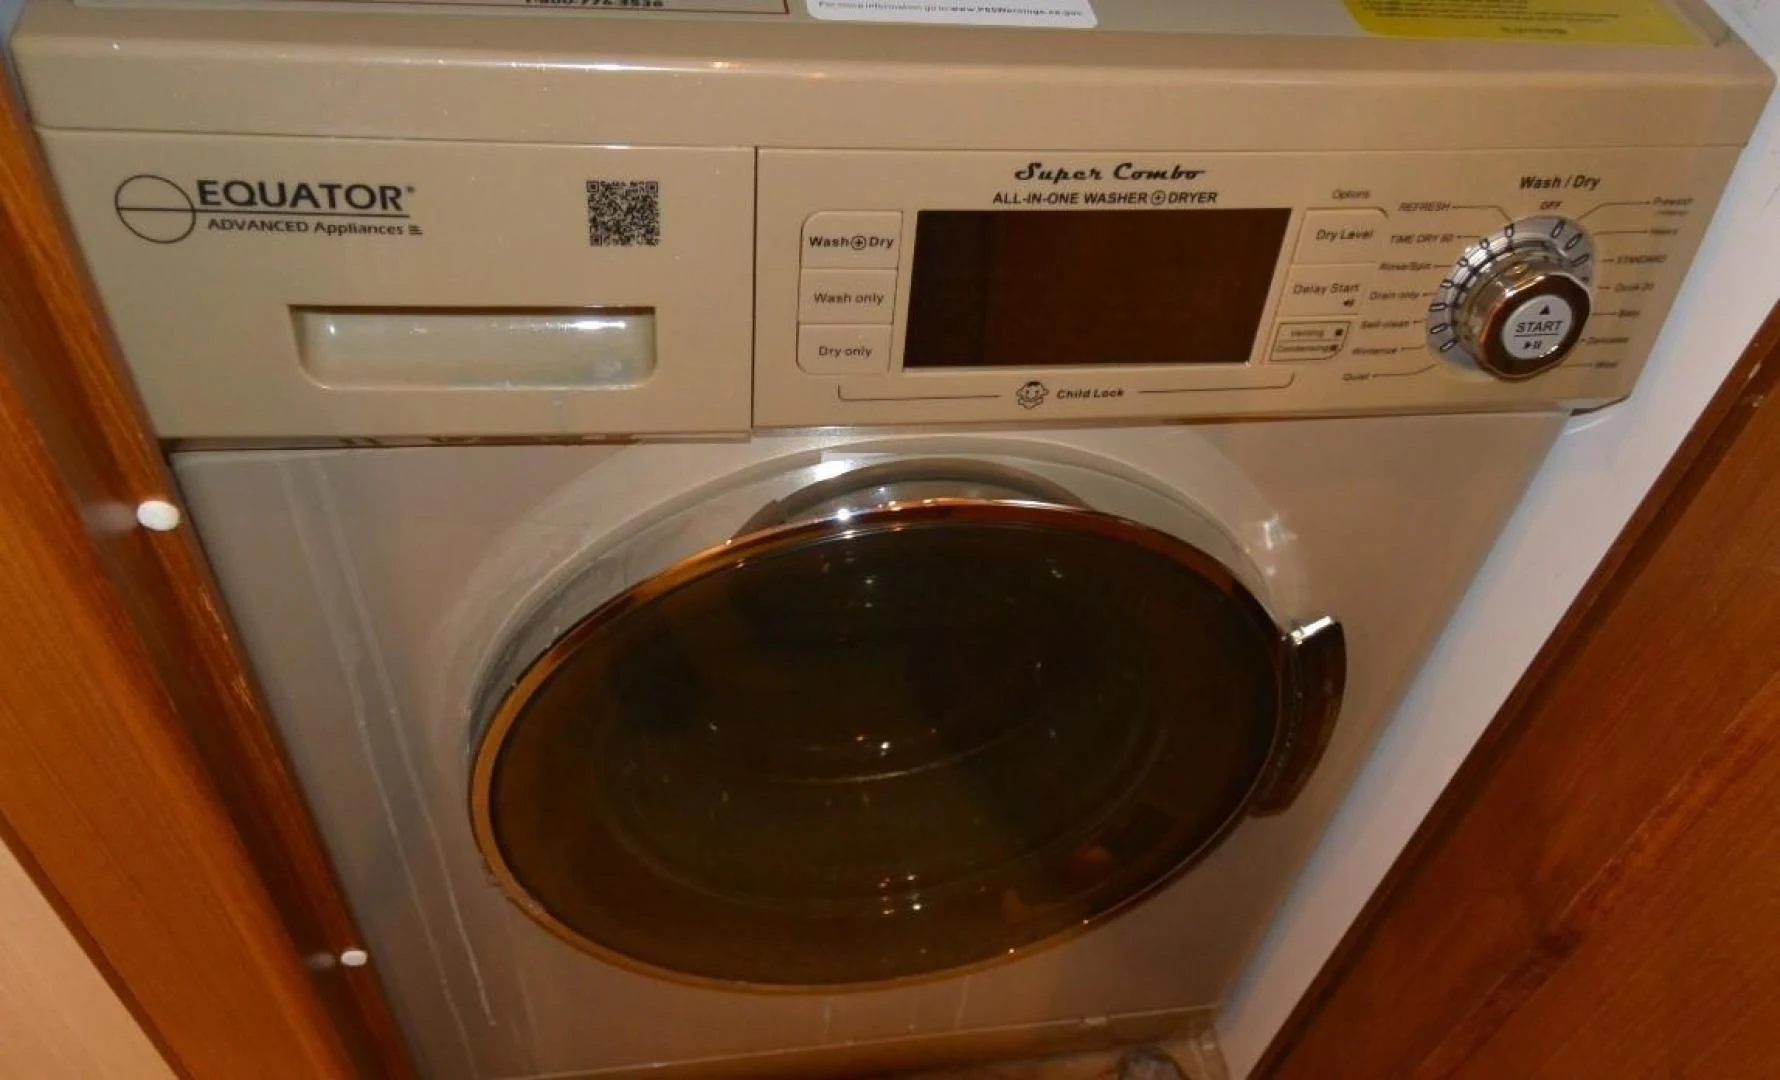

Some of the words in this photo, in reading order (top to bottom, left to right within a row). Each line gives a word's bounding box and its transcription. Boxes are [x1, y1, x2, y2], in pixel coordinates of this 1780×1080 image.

[1014, 162, 1104, 184] Super
[1112, 162, 1206, 181] Combo
[1520, 175, 1562, 189] Wash
[1573, 174, 1602, 191] Dry
[196, 179, 404, 211] EQUATOR
[992, 191, 1080, 205] ALL-IN-ONE
[1084, 191, 1148, 205] WASHER
[1168, 191, 1219, 205] DRYER
[207, 218, 309, 234] ADVANCED
[314, 221, 404, 237] Appliances
[1315, 228, 1338, 242] Dry
[1340, 229, 1374, 240] Level
[809, 236, 850, 248] Wash
[869, 236, 894, 248] Dry
[1293, 284, 1328, 295] Delay
[1329, 282, 1360, 294] Start
[813, 292, 851, 304] Wash
[855, 293, 884, 305] only
[1516, 320, 1565, 333] START
[819, 345, 840, 357] Dry
[845, 346, 872, 358] only
[1057, 389, 1090, 400] Child
[1093, 388, 1125, 398] Lock
